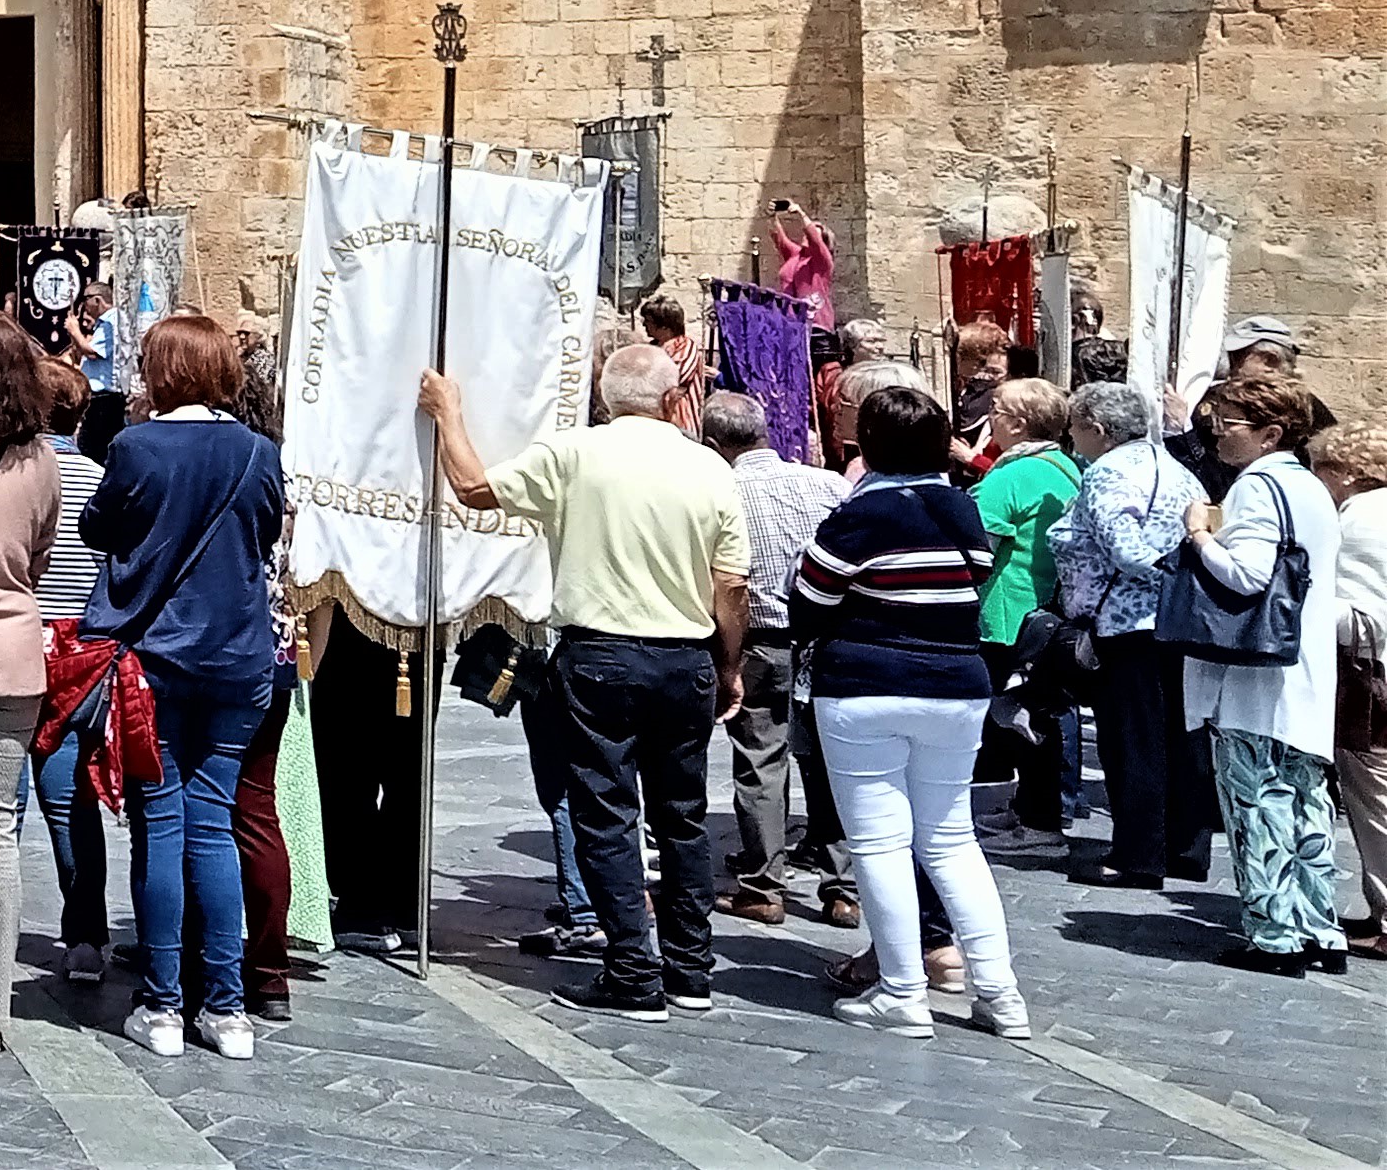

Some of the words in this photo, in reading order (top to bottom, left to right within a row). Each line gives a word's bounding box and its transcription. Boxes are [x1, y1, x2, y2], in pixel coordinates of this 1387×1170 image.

[456, 228, 550, 272] SEÑORA
[552, 270, 582, 324] DEL
[301, 268, 336, 404] COFRADIA
[556, 335, 583, 432] CARME
